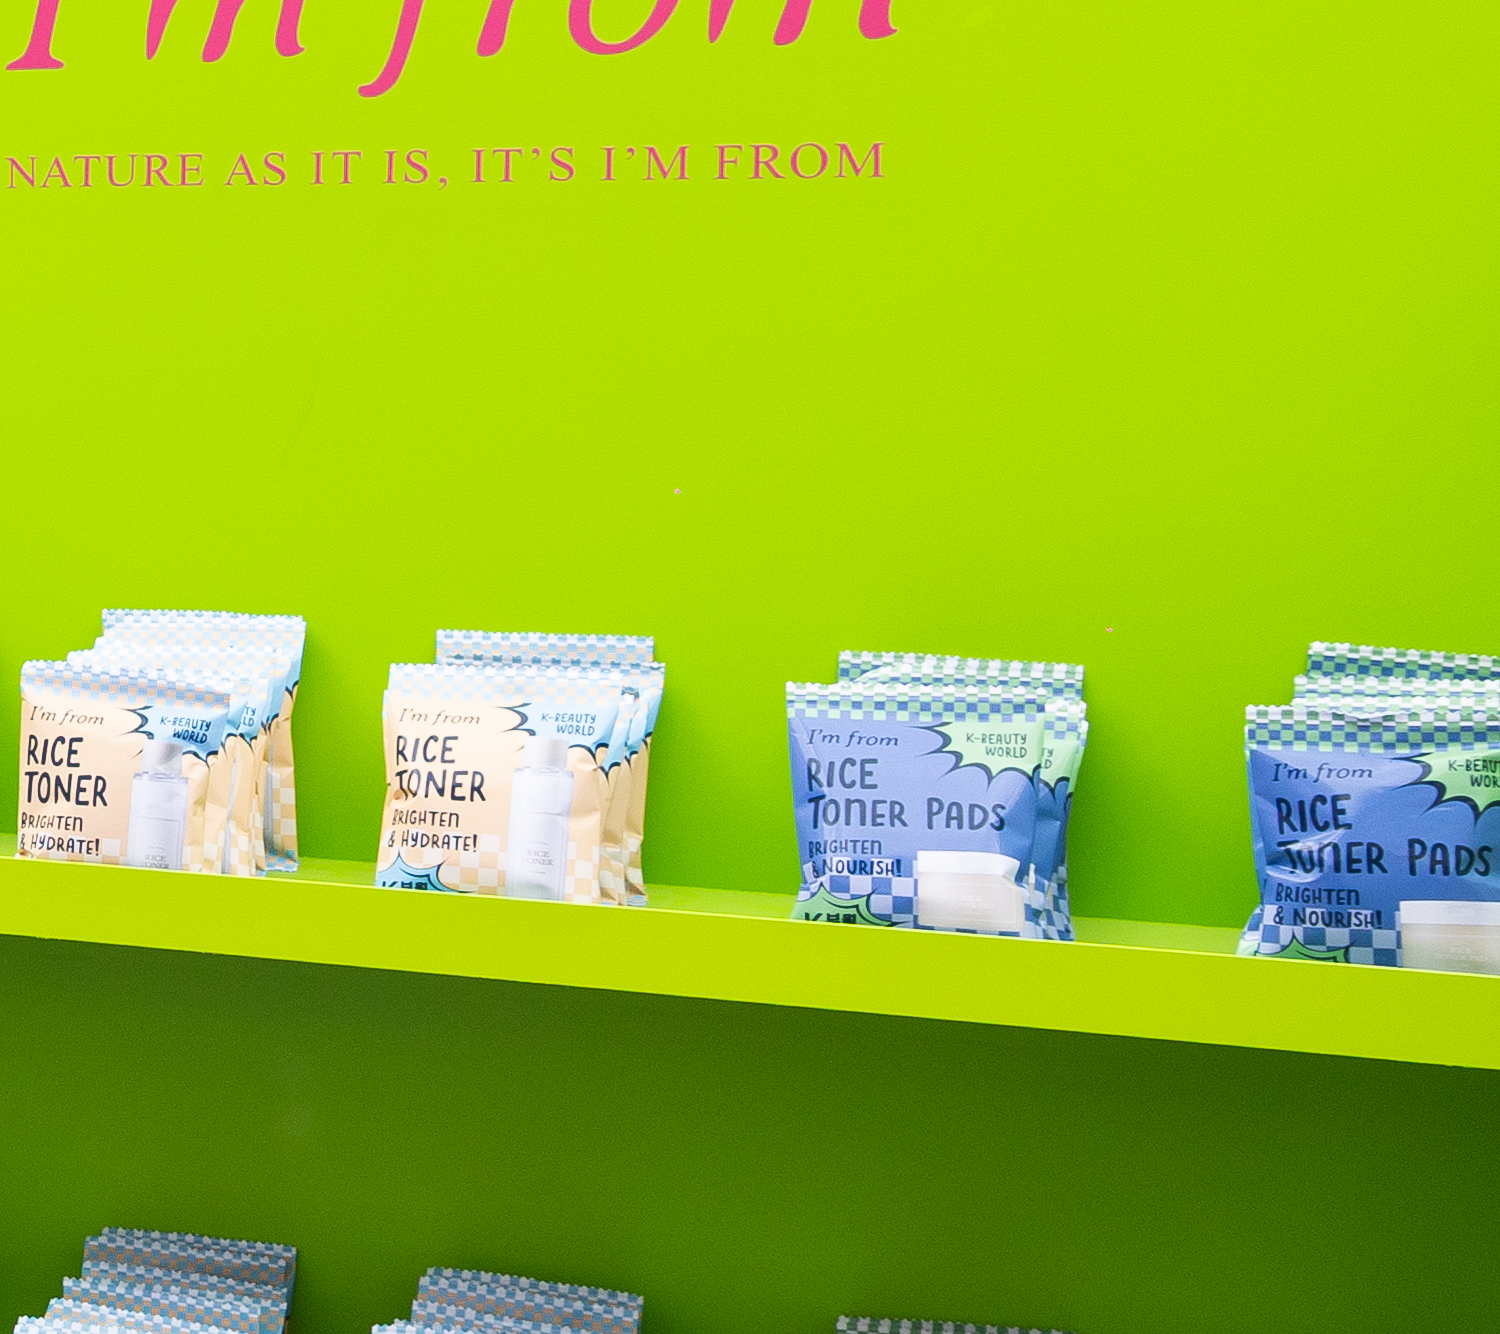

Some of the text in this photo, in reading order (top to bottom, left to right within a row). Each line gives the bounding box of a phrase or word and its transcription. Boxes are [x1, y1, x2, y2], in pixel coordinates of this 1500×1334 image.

[6, 140, 886, 192] NATURE AS IT IS, IT'S I'M FROM
[59, 709, 104, 726] from
[160, 716, 211, 731] K-BEAUTY
[172, 728, 208, 744] WORLD
[845, 731, 898, 747] from
[966, 733, 1027, 744] K-BEAUTY
[27, 734, 83, 767] RICE
[985, 746, 1027, 758] WORLD
[807, 757, 878, 792] RICE
[25, 771, 107, 807] TONER
[808, 794, 1006, 831] TONER PADS
[21, 812, 83, 832] BRIGHTEN
[30, 834, 100, 856] HYDRATE!
[809, 840, 882, 858] BRIGHTEN
[821, 858, 901, 876] NOURISH!
